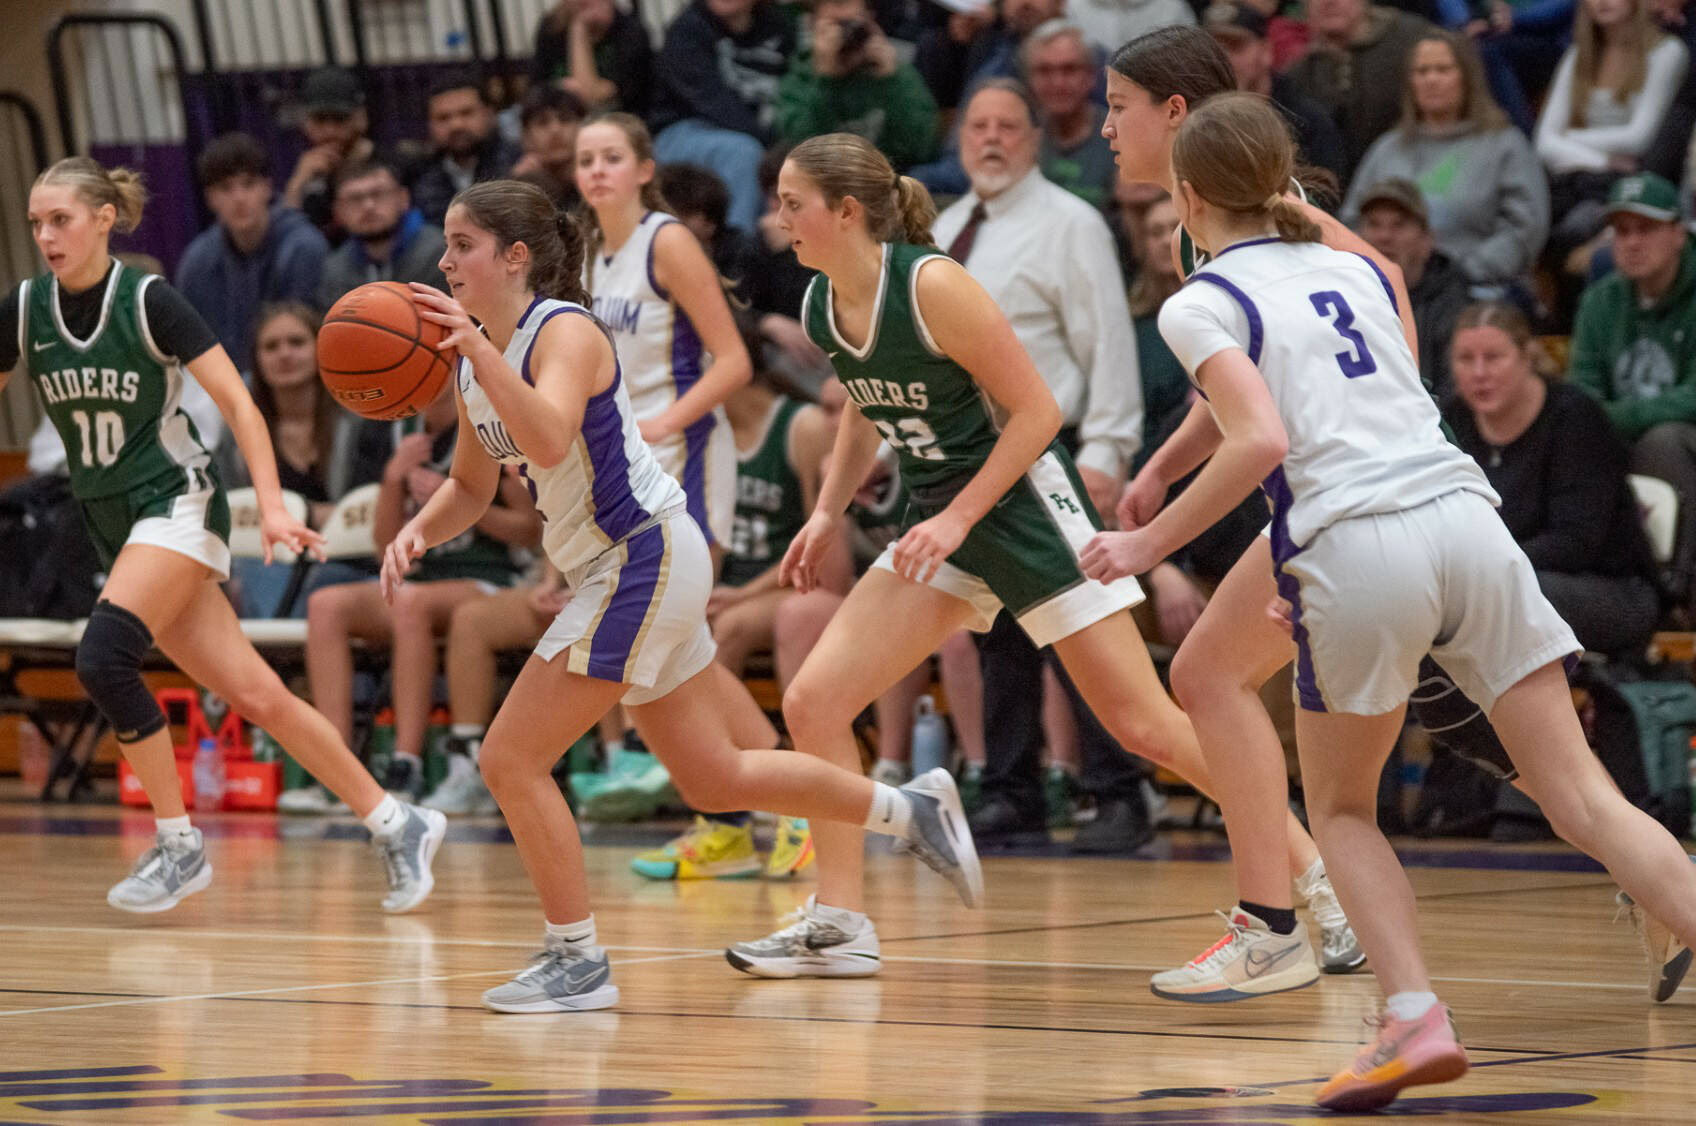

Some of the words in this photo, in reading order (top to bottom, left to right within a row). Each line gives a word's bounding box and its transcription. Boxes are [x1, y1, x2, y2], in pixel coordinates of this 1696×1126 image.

[1308, 290, 1377, 379] 3
[39, 367, 140, 404] RIDERS
[72, 410, 125, 467] 10
